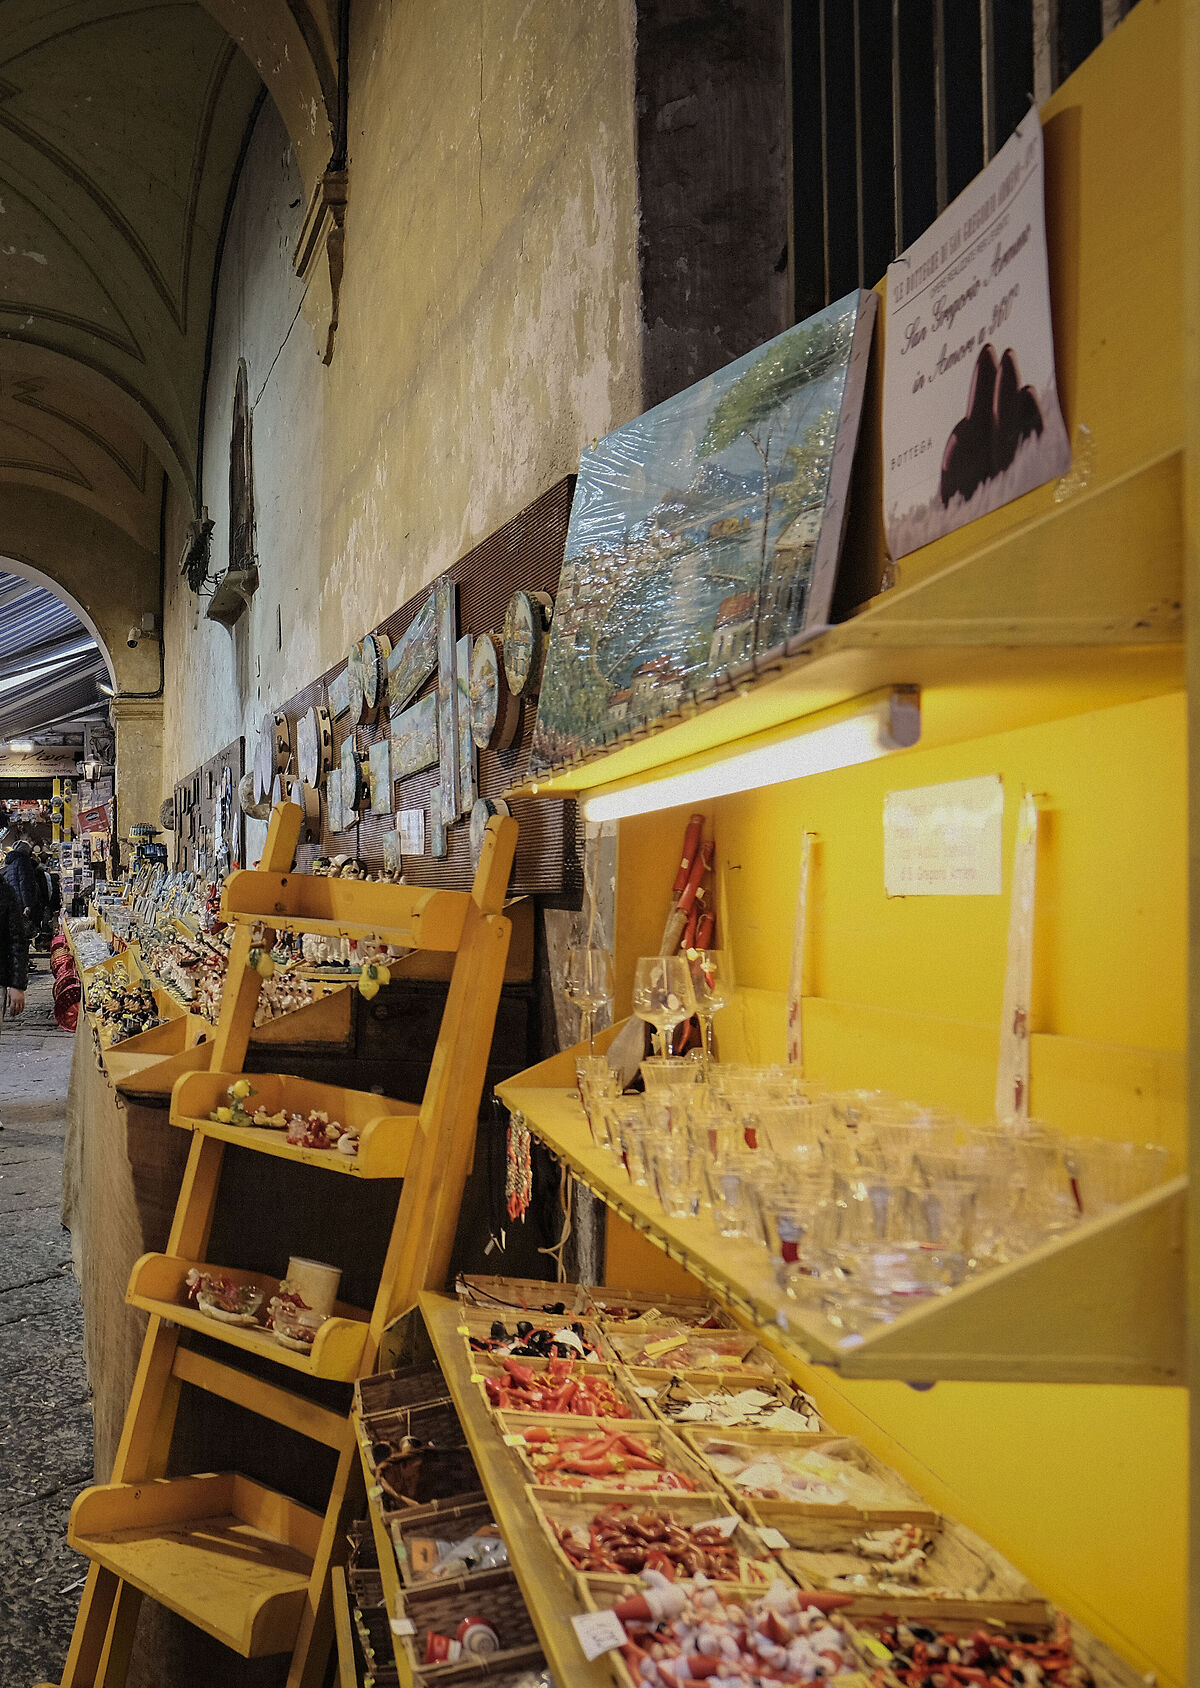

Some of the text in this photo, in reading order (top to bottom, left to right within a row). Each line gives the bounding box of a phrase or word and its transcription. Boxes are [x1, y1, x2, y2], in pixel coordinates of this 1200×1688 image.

[901, 315, 927, 355] San
[912, 370, 926, 394] in
[890, 437, 933, 472] BOTTEGA
[21, 748, 71, 761] Vivo
